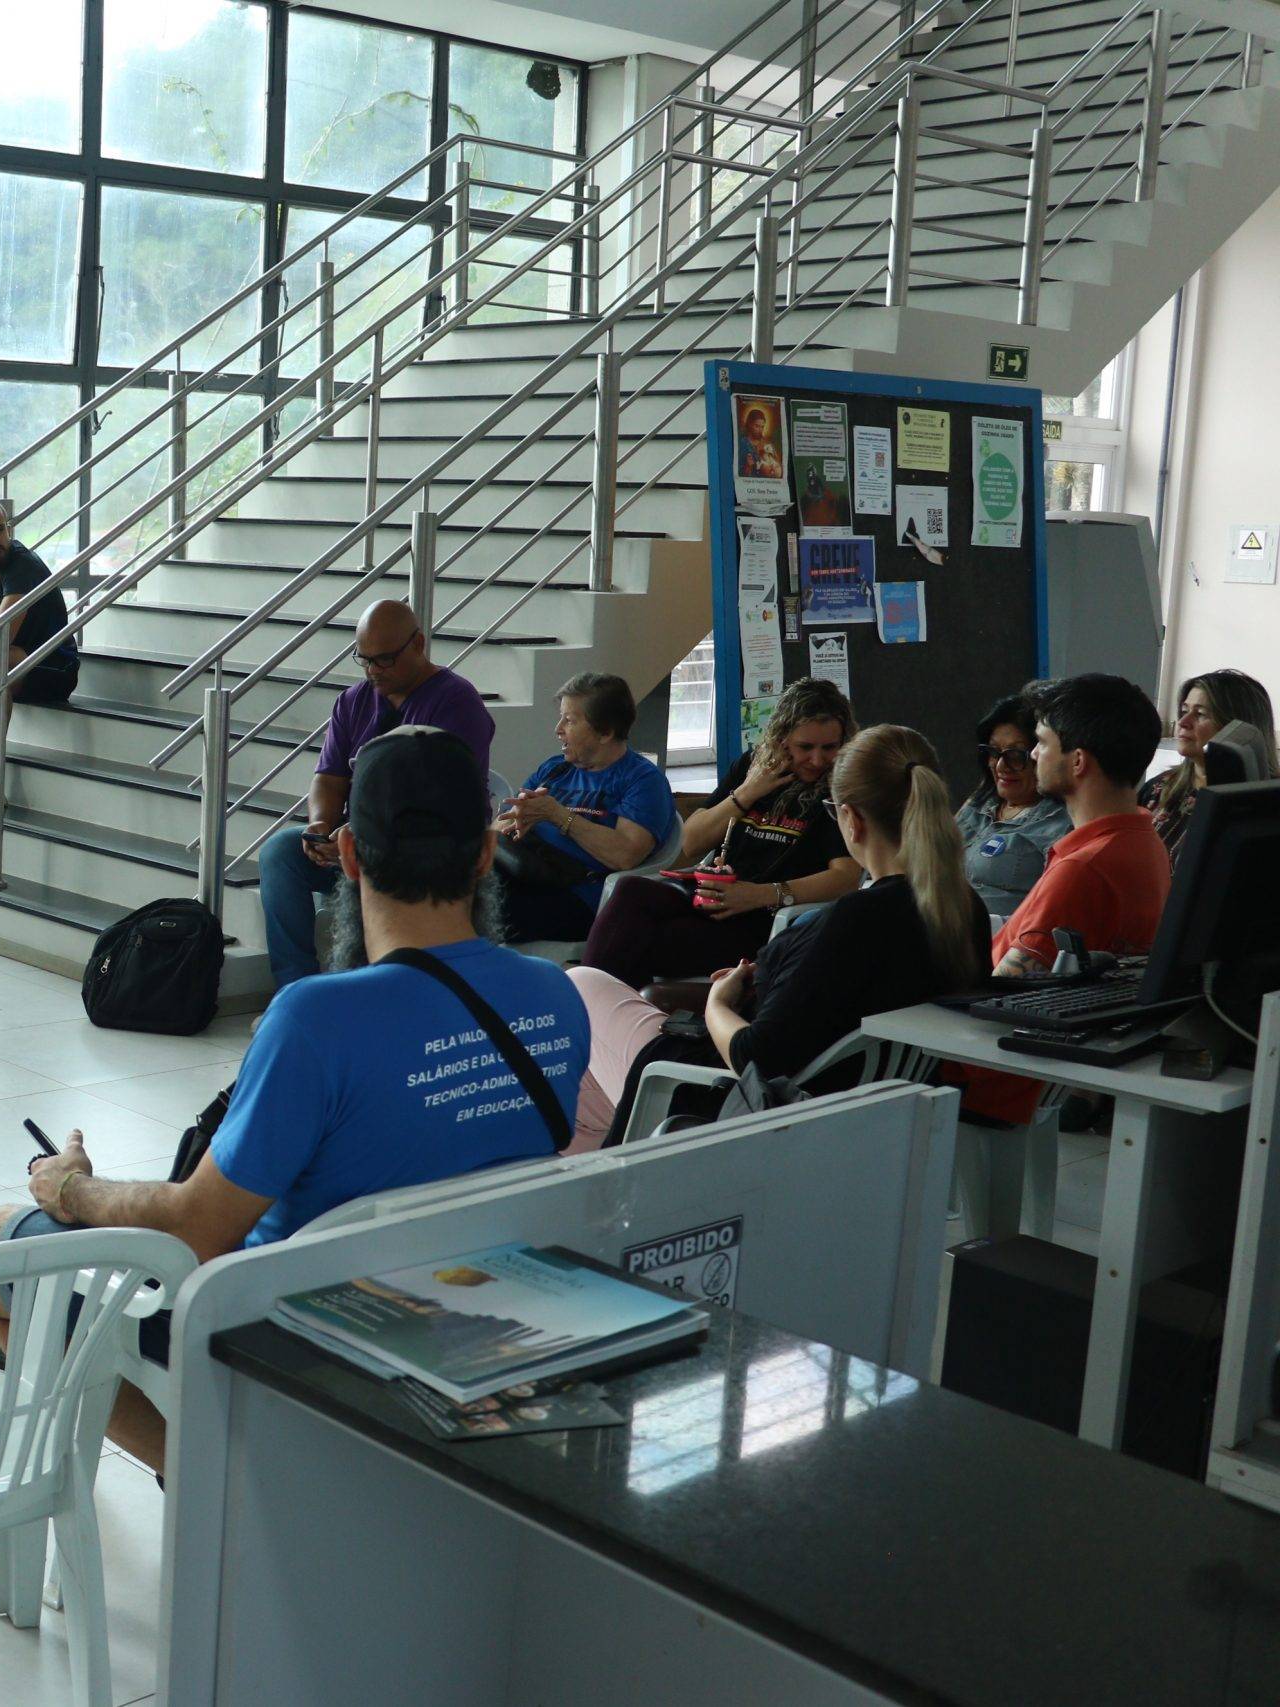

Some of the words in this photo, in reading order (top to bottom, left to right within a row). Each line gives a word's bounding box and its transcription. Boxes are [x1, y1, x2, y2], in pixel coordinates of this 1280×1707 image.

[425, 1036, 456, 1055] PELA
[536, 1014, 555, 1029] DOS
[406, 1058, 469, 1087] SALÁRIOS
[471, 1056, 478, 1068] E
[481, 1052, 496, 1067] DA
[553, 1036, 571, 1051] DOS
[456, 1106, 474, 1122] EM
[476, 1092, 536, 1118] EDUCAÇÃ
[629, 1226, 734, 1274] PROIBIDO
